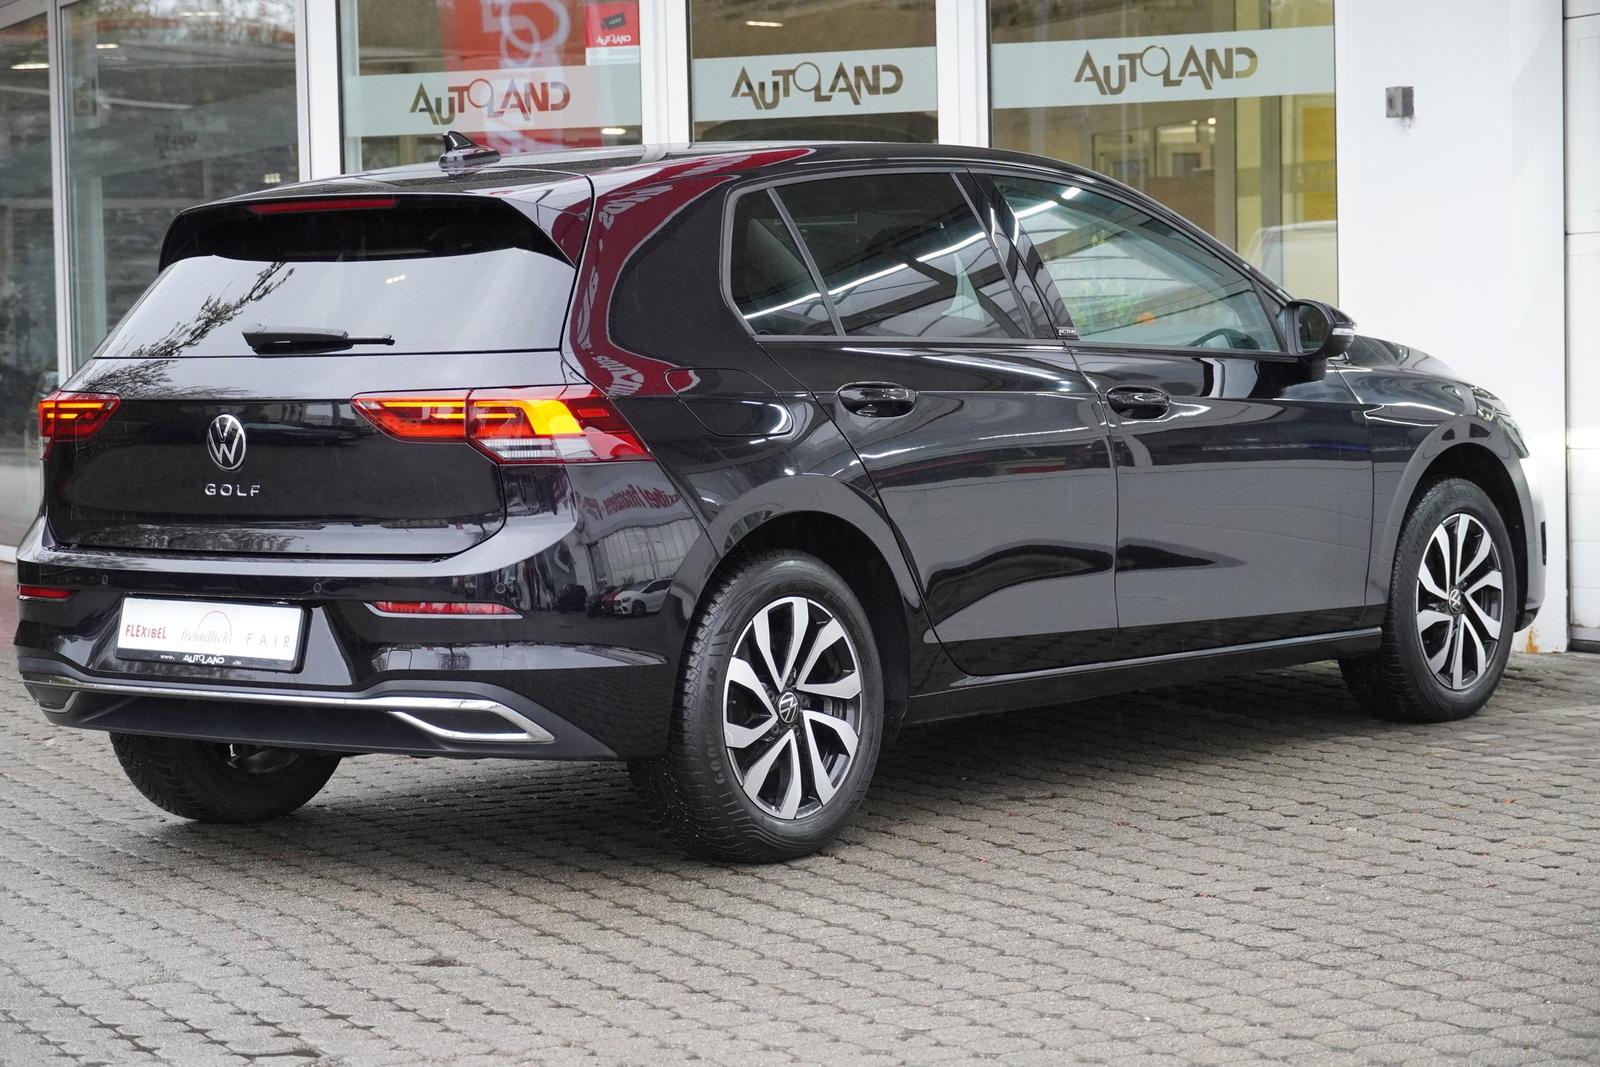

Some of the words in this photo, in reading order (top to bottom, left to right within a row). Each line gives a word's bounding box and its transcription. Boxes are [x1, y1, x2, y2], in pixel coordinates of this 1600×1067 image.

[596, 34, 631, 45] AUTOLAND
[1073, 44, 1259, 96] AUTOLAND
[731, 60, 904, 111] AUTOLAND
[409, 78, 571, 126] AUTOLAND
[1058, 328, 1077, 336] ACTI
[204, 483, 261, 497] GOLF
[125, 624, 167, 640] FLEXIBEL
[246, 632, 290, 649] FAIR
[182, 654, 225, 665] AUTOLAND
